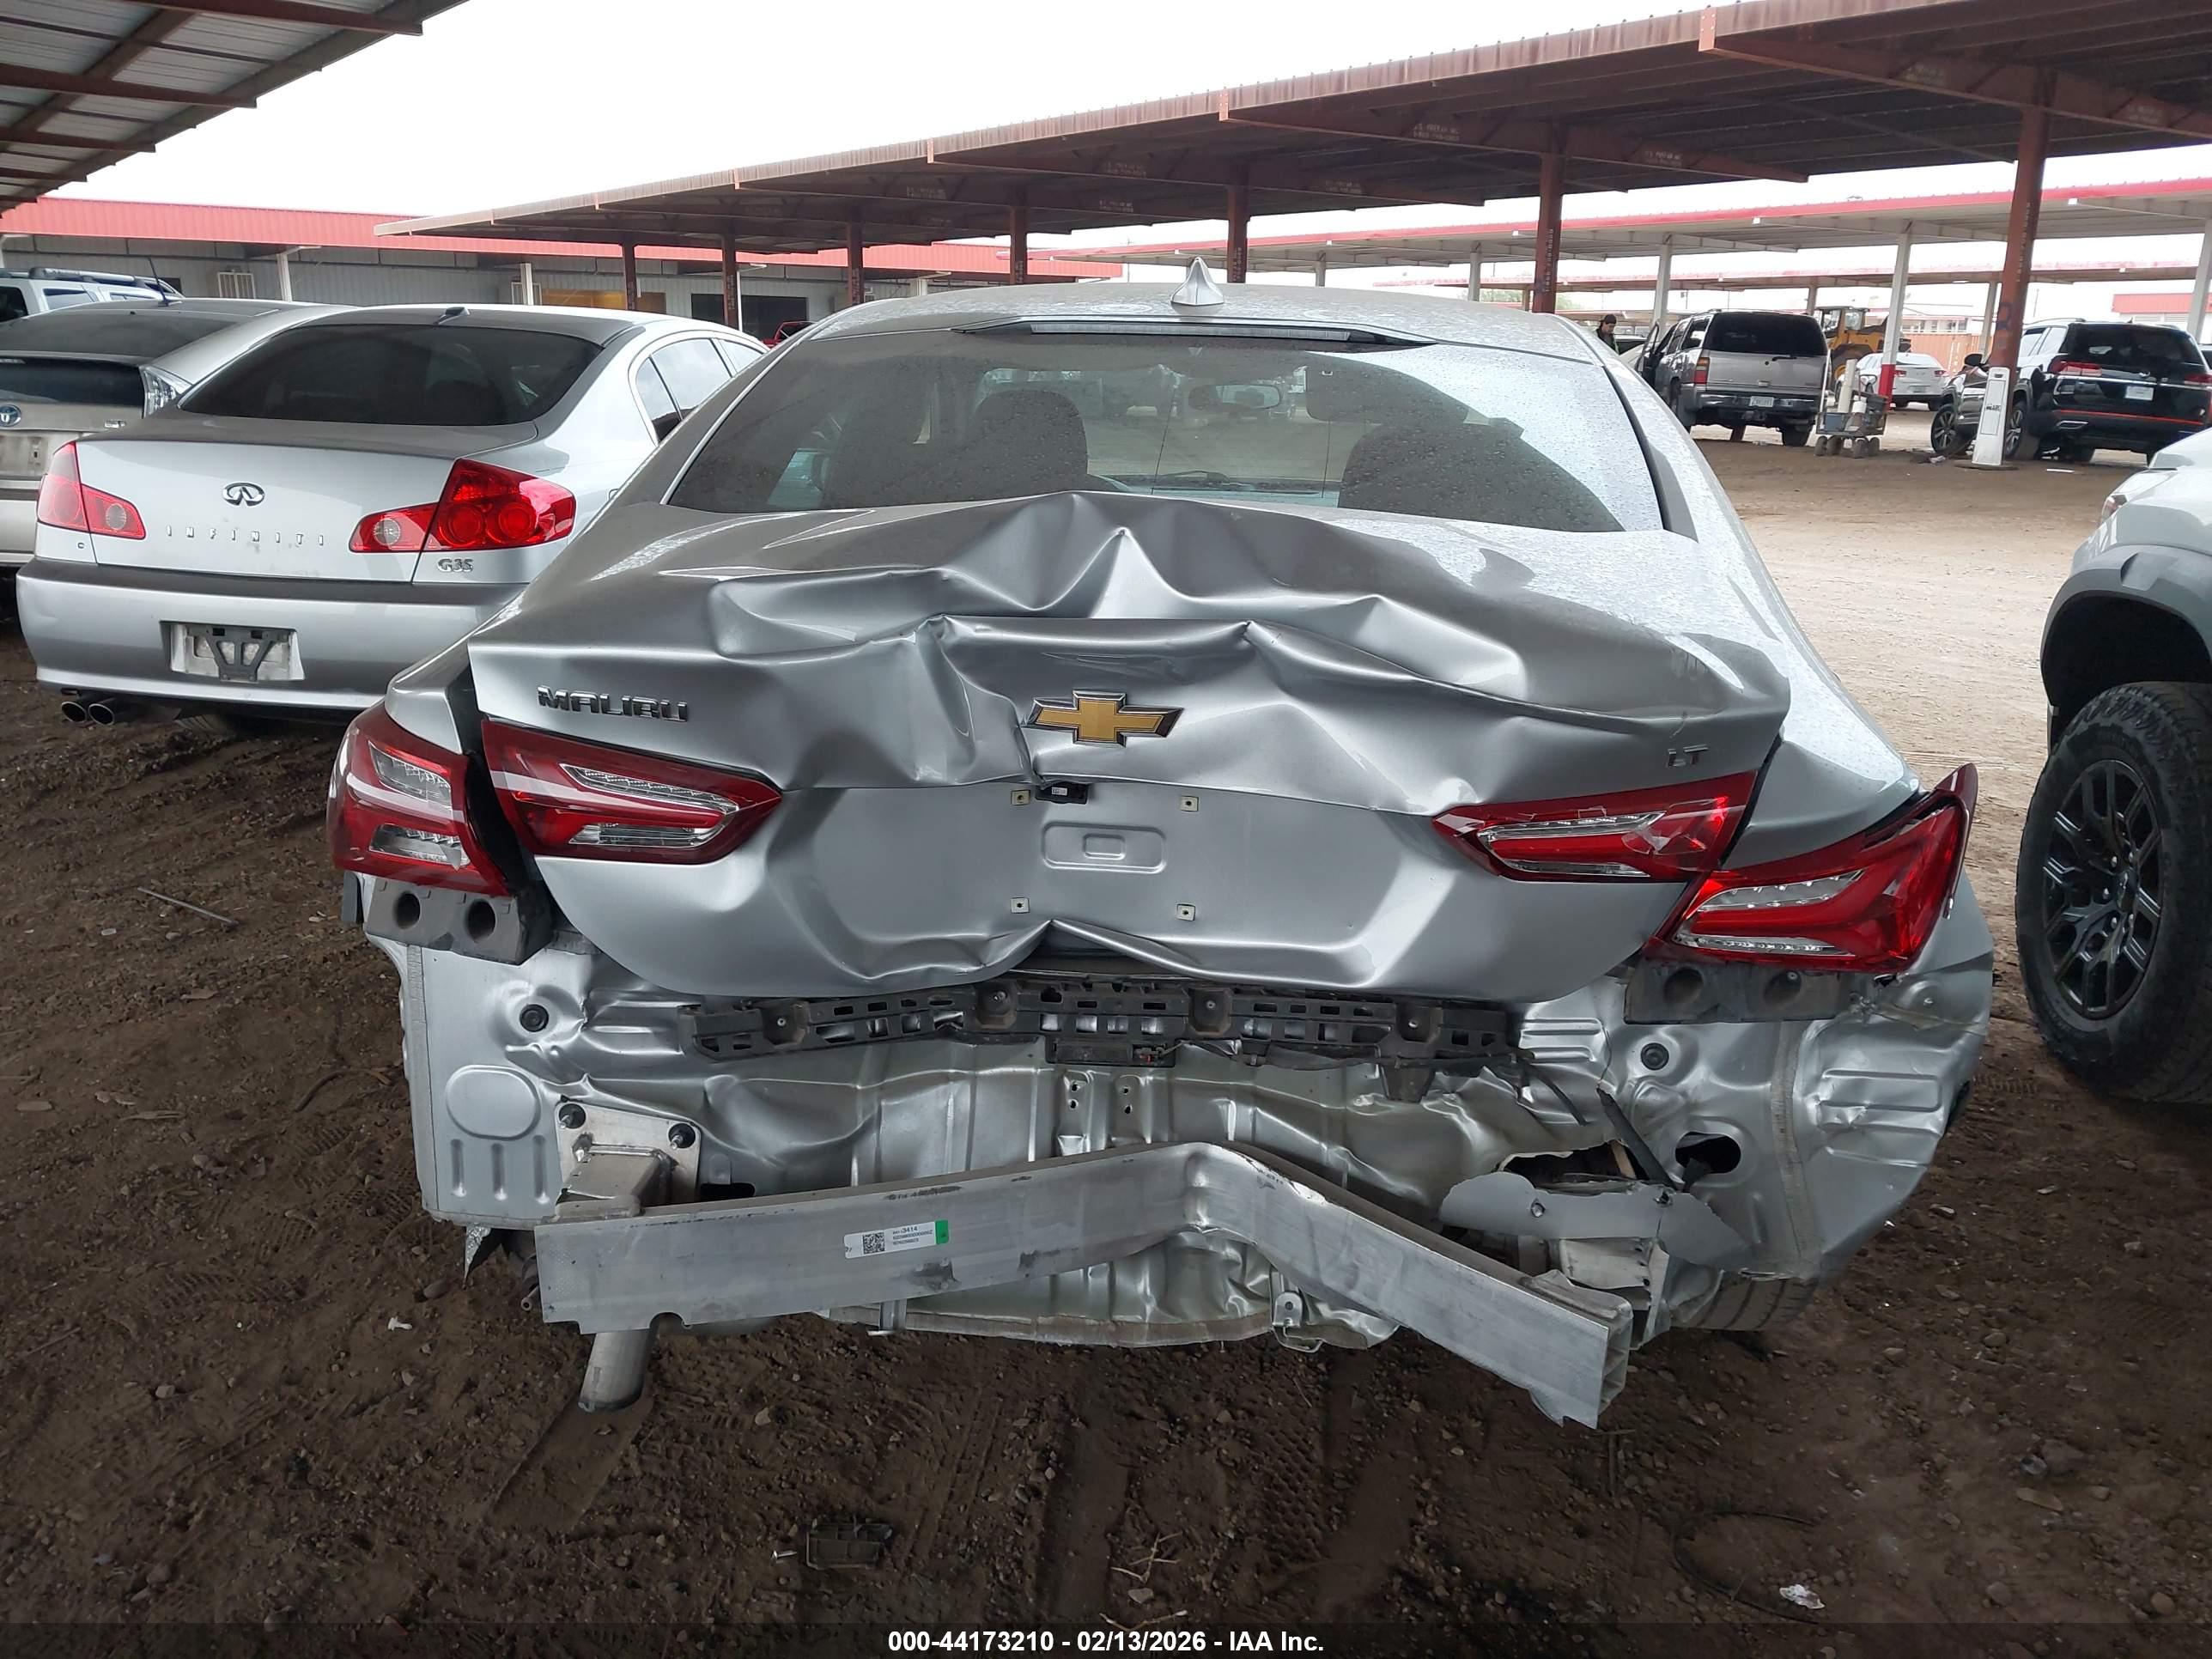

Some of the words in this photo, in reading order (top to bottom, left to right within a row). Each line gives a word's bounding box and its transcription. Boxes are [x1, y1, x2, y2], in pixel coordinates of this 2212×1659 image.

[167, 525, 324, 546] INFINITI
[438, 558, 473, 572] G35
[537, 684, 689, 722] MALIBU
[1666, 744, 1709, 768] LT
